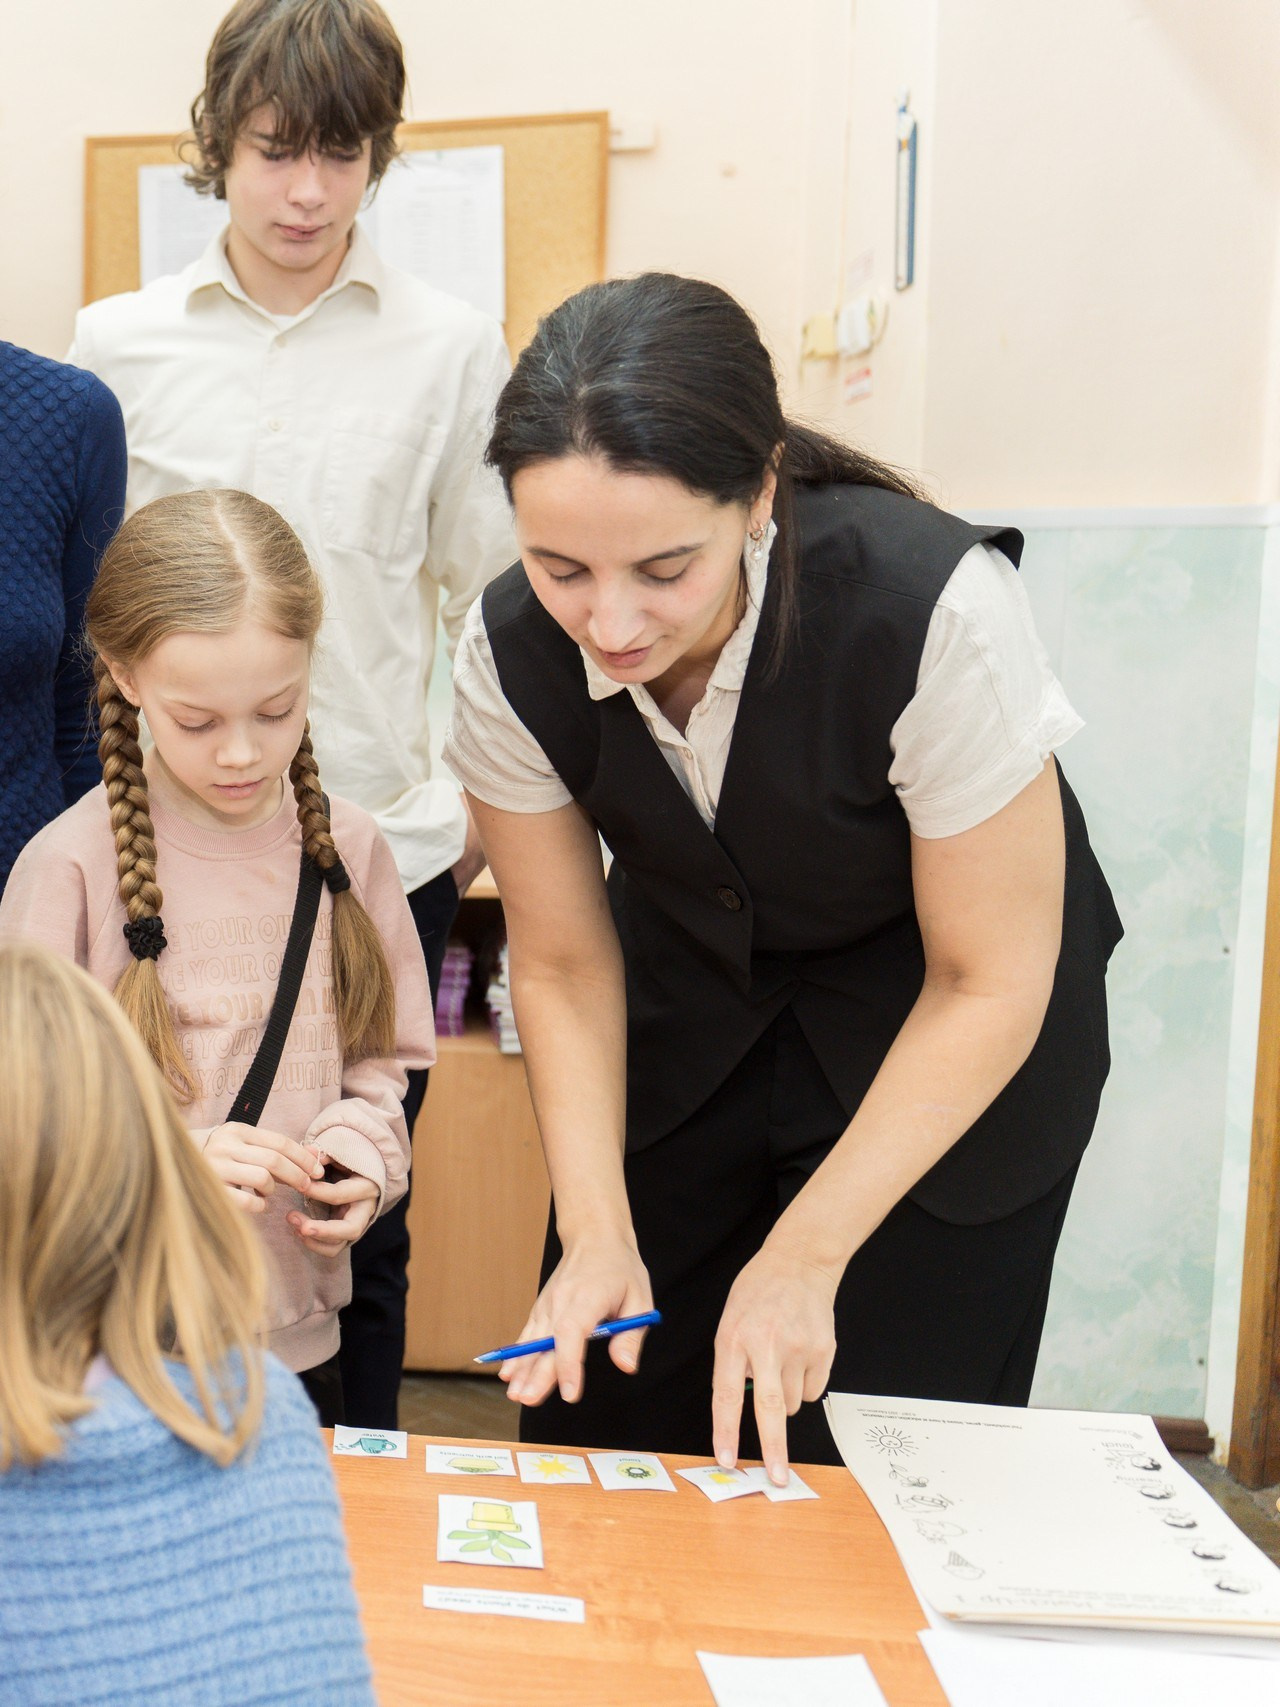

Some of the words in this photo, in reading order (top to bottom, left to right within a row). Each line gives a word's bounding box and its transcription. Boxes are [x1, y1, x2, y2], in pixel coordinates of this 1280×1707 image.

[184, 916, 255, 952] YOUR
[190, 953, 259, 988] YOUR
[196, 992, 263, 1025] YOUR
[199, 1027, 258, 1059] YOUR
[285, 1023, 318, 1053] WN
[197, 1064, 250, 1098] YOU
[1101, 1441, 1134, 1450] touch
